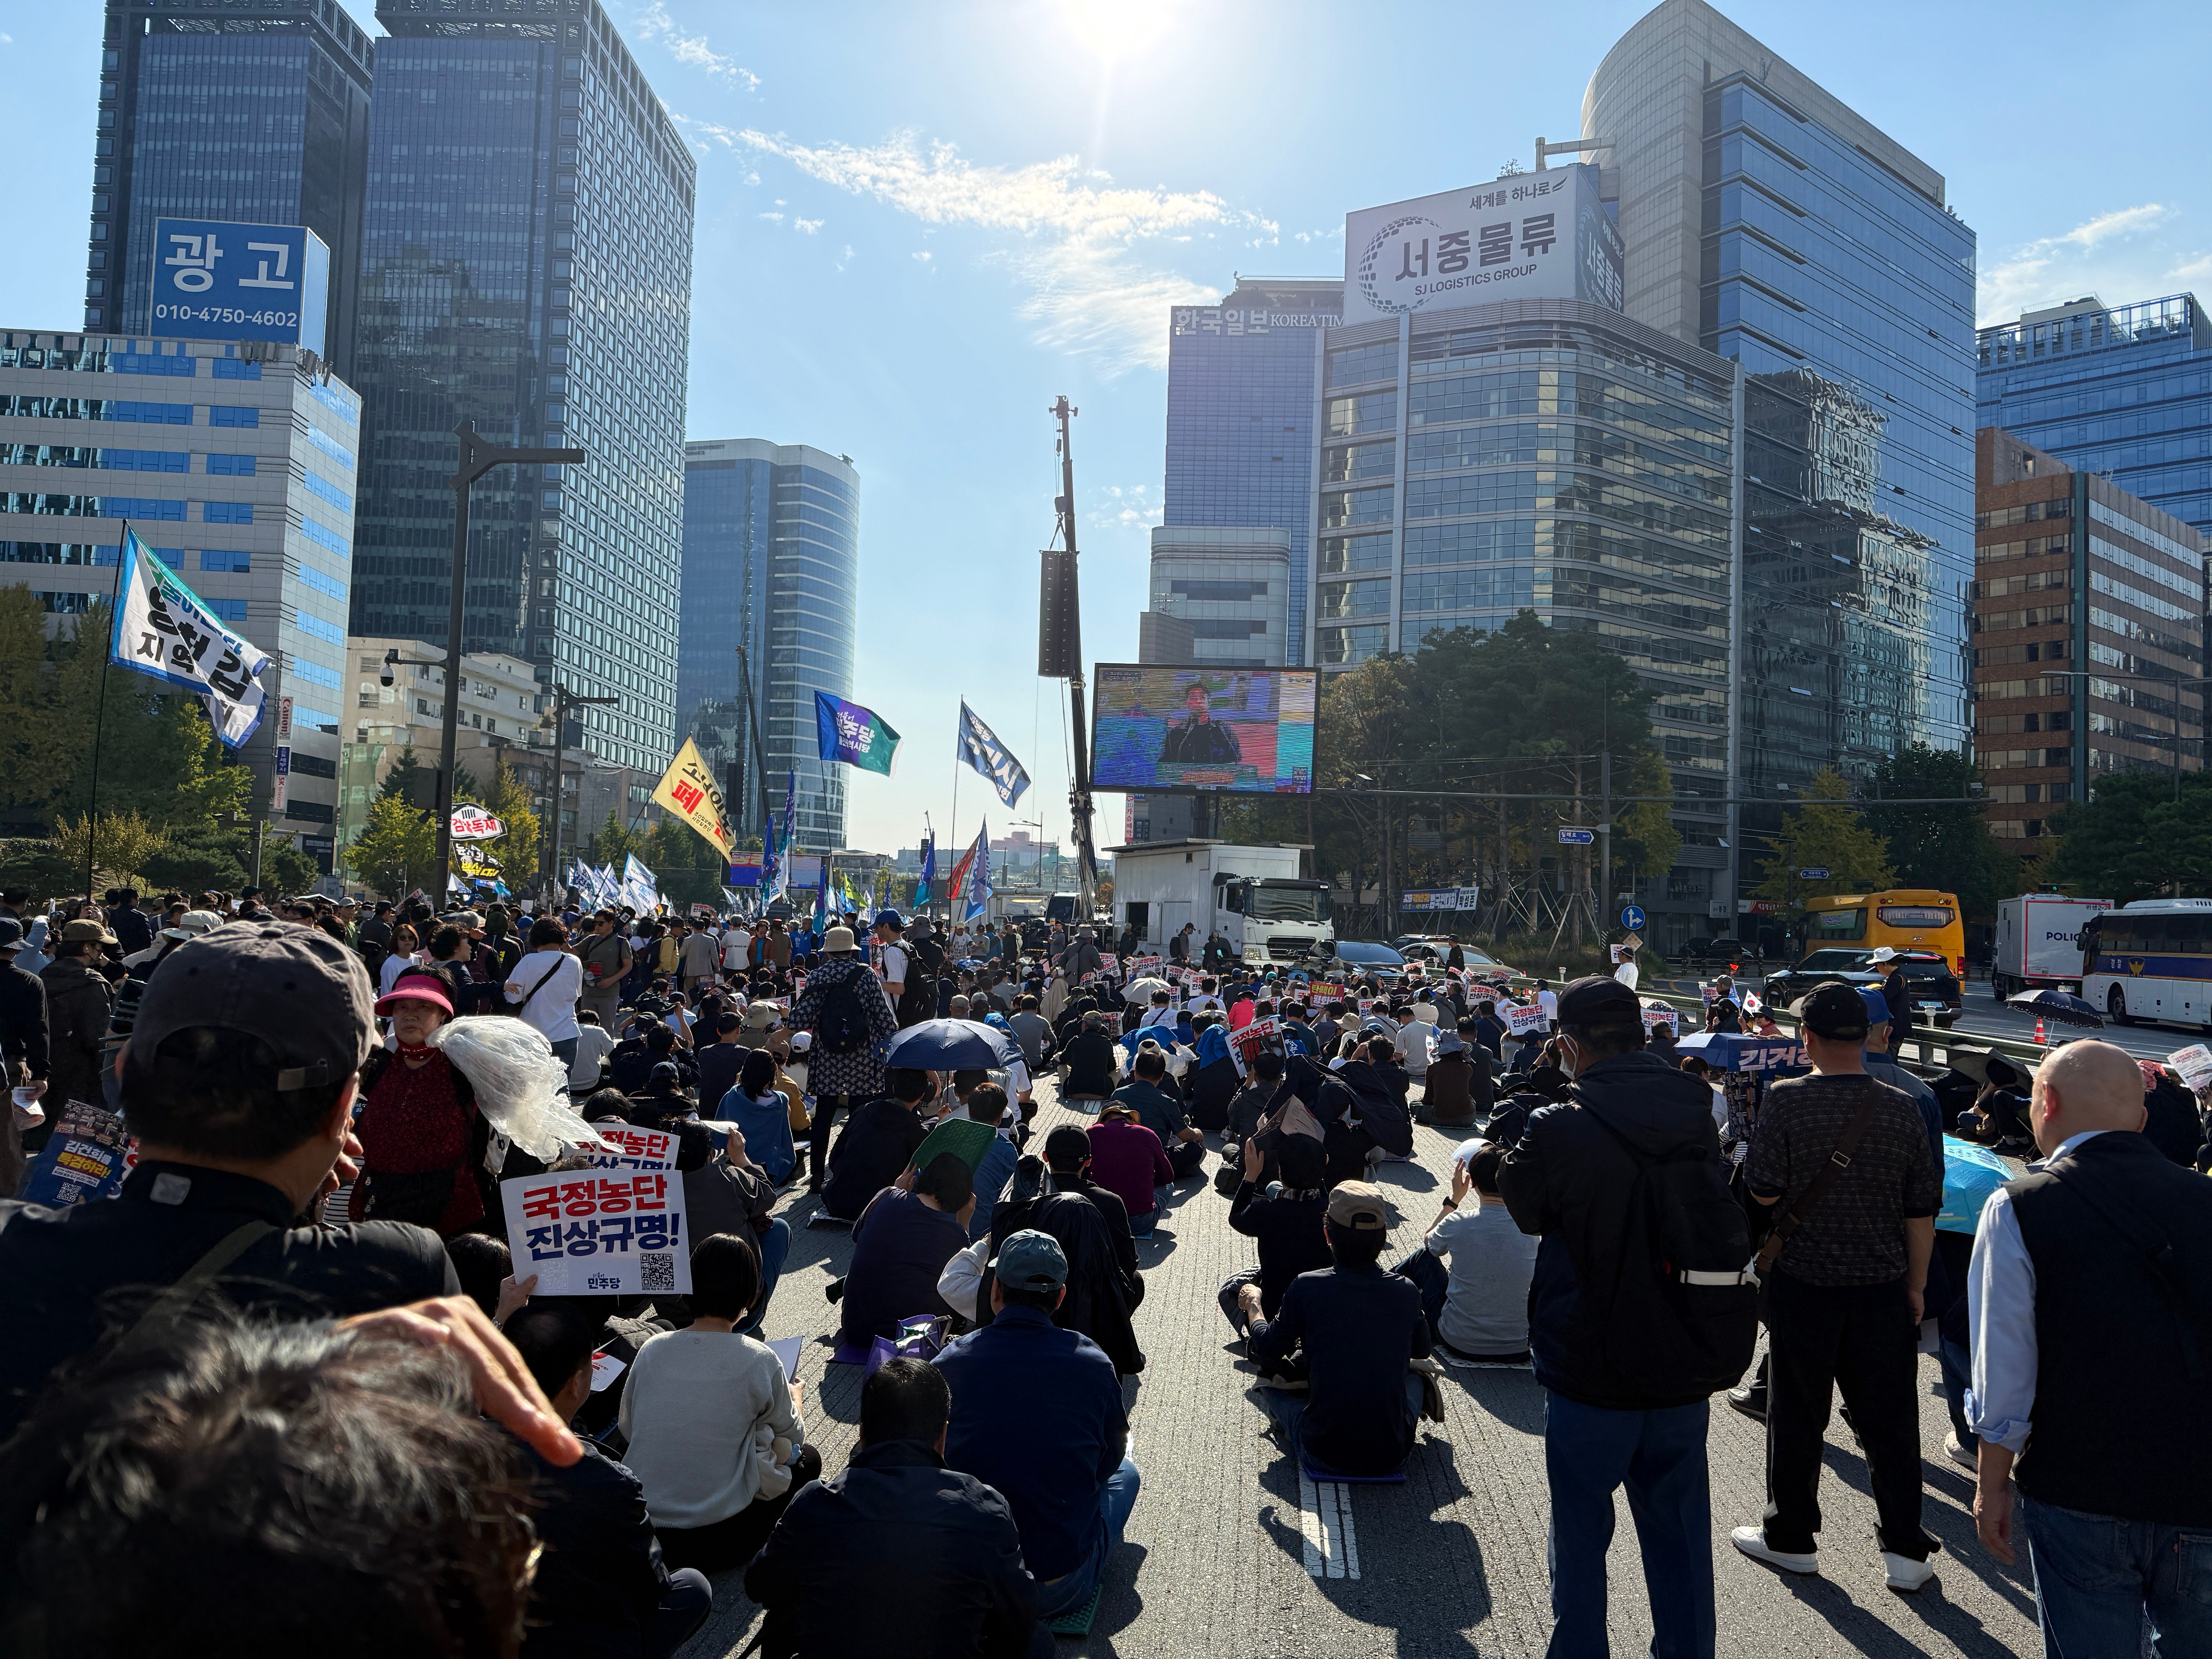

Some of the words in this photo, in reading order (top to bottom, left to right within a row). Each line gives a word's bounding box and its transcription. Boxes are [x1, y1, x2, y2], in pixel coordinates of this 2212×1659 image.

[1470, 191, 1508, 210] 세계를
[1511, 182, 1550, 201] 하나로
[1396, 213, 1556, 282] 서중물류
[165, 234, 294, 292] 광고
[1587, 232, 1621, 312] 서중물류
[1415, 285, 1428, 295] SJ
[1430, 273, 1491, 293] LOGISTICS
[1494, 264, 1537, 281] GROUP
[156, 304, 297, 327] 010-4750-4602
[1176, 309, 1269, 336] 한국일보
[1270, 315, 1317, 326] KOREA
[281, 698, 291, 732] Canon
[837, 711, 854, 722] 더불어
[836, 717, 875, 744] 민주당
[278, 777, 285, 786] SK
[2046, 932, 2079, 941] POLIC
[1312, 984, 1337, 996] 탄핵이
[1469, 993, 1498, 1002] 진상규명!
[1470, 987, 1497, 995] 국정농단
[1511, 1005, 1542, 1018] 국정농단
[1513, 1013, 1546, 1027] 진상규명!
[57, 1152, 112, 1178] 특검하라!
[64, 1140, 112, 1166] 김건희를
[522, 1175, 668, 1220] 국정농단
[526, 1213, 680, 1261] 진상규명!
[588, 1278, 621, 1290] 민주당
